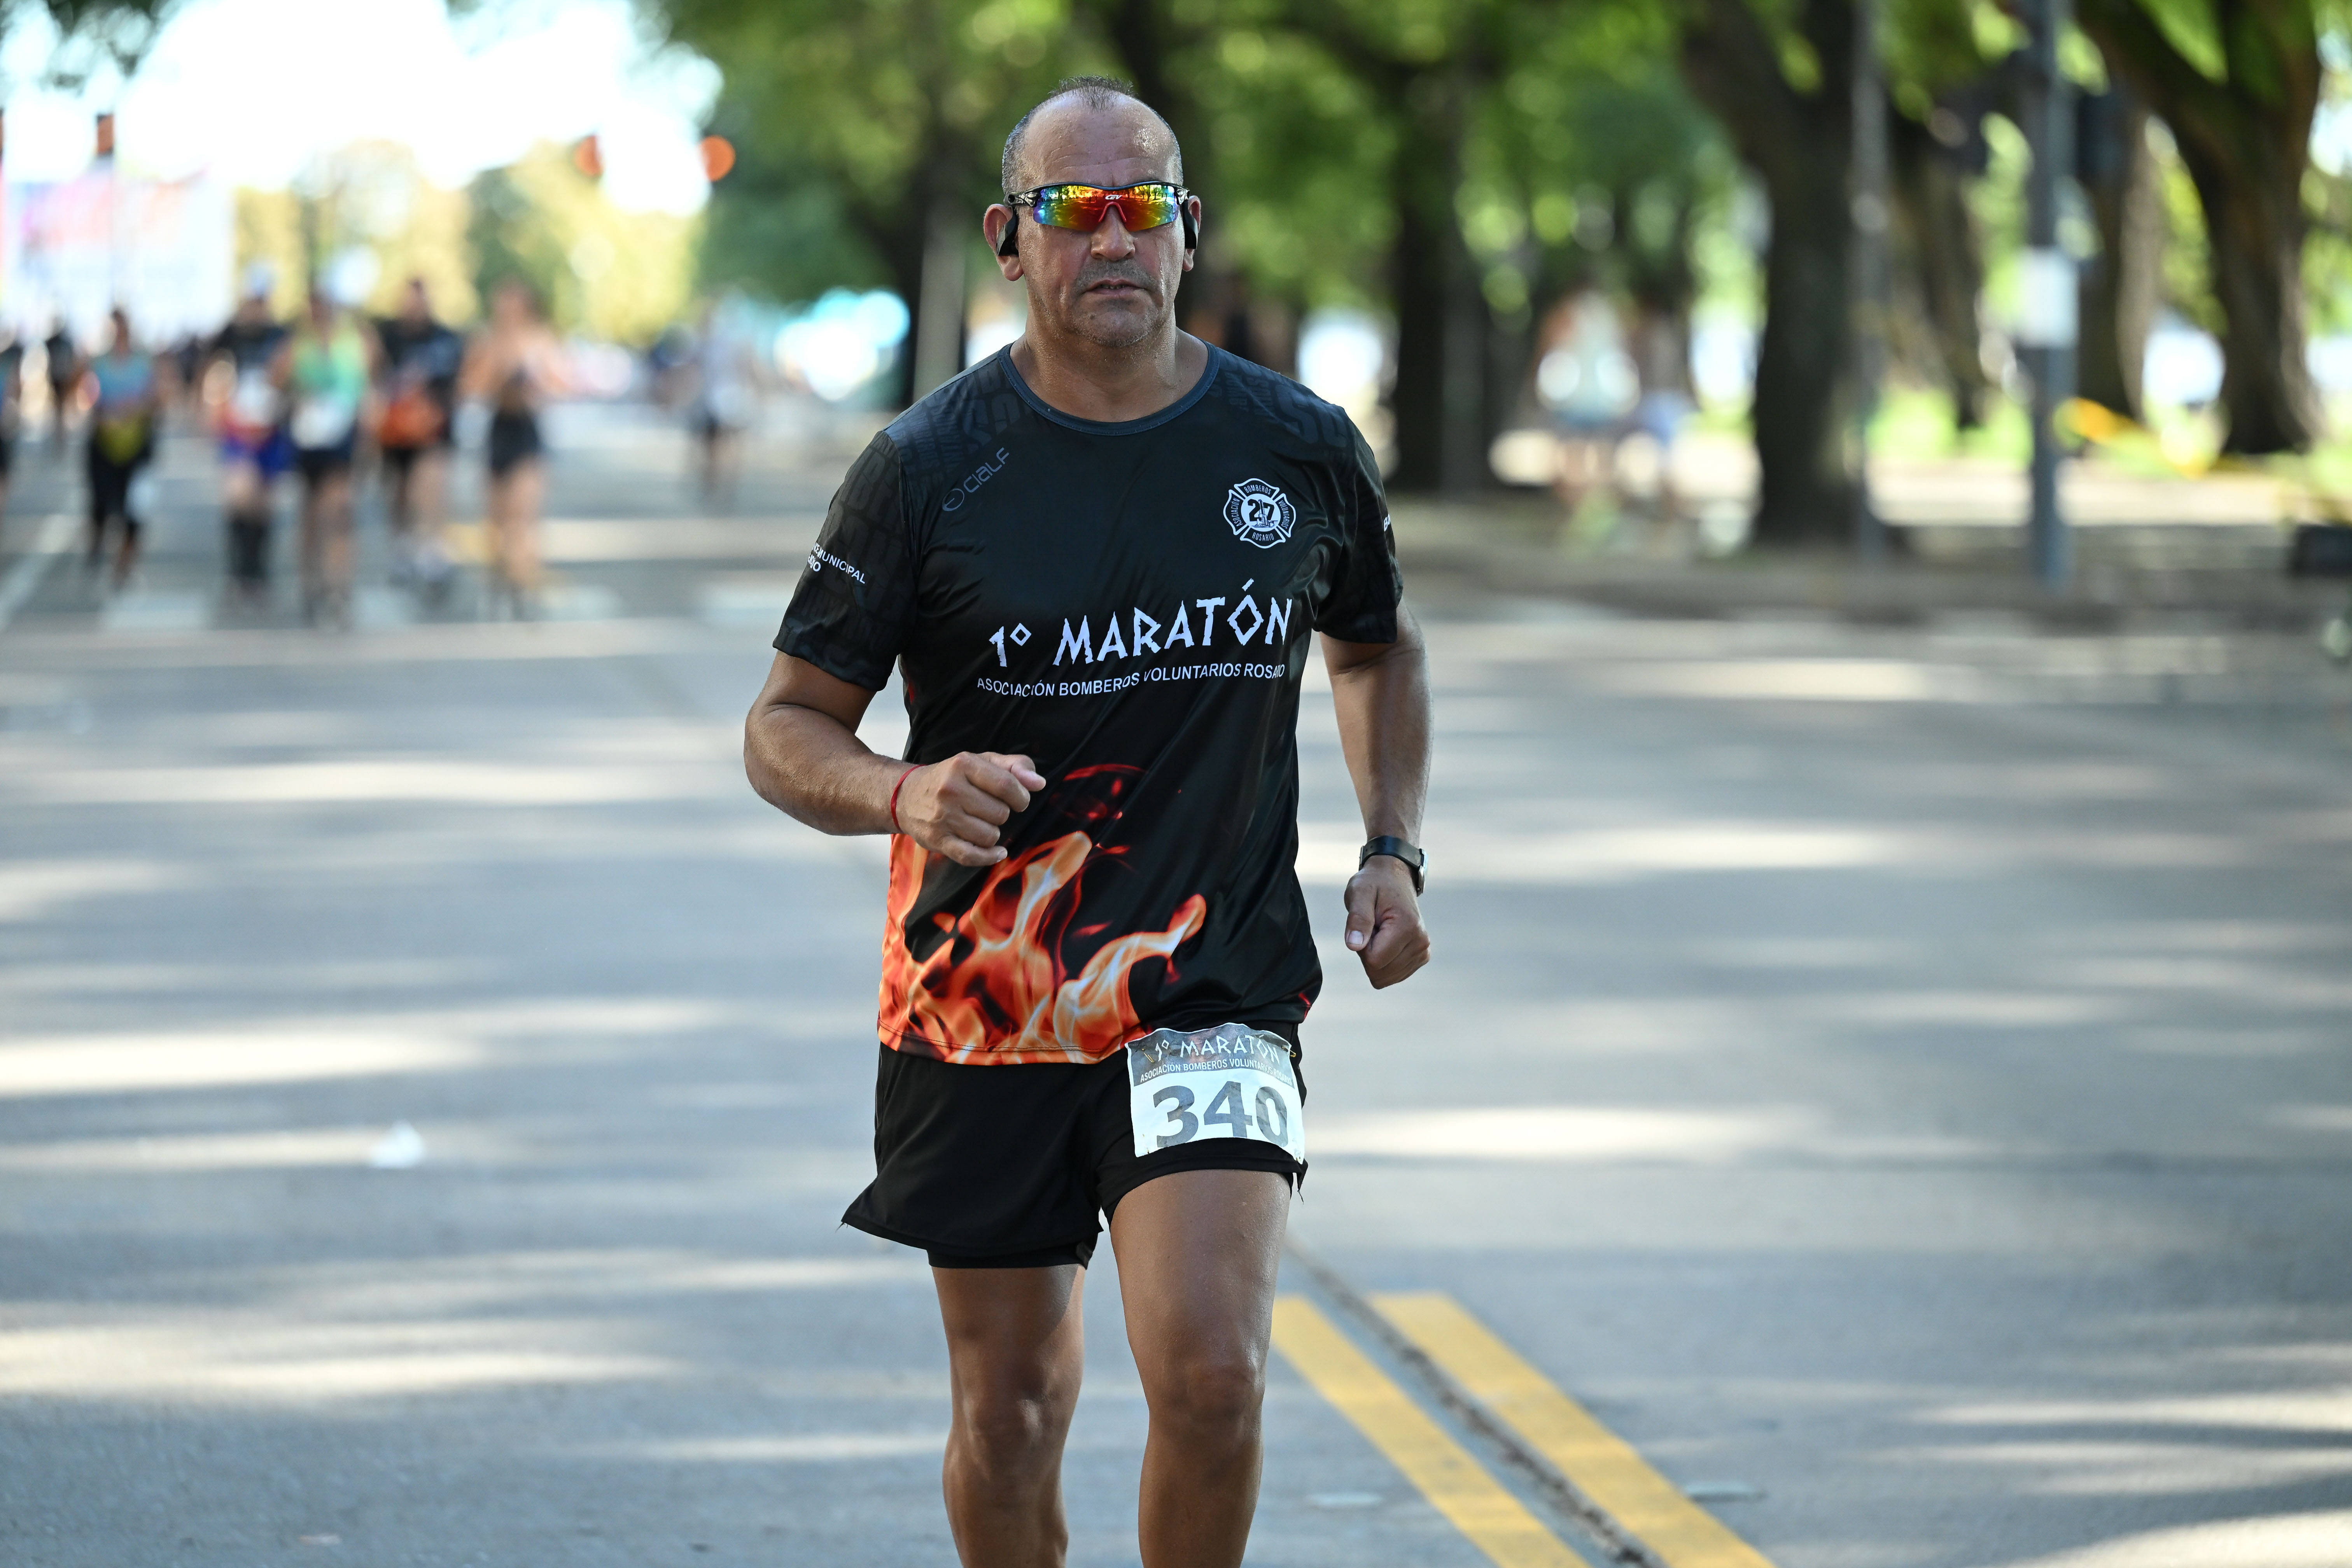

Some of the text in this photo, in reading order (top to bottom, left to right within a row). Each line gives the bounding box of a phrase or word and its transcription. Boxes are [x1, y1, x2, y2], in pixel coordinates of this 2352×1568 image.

[1244, 485, 1271, 495] BOMBEROS
[1247, 499, 1275, 522] 27
[1278, 500, 1290, 529] VOLUNTARIOS
[1251, 532, 1274, 541] ROSARIO
[1052, 578, 1292, 666] MARATÓN
[977, 677, 1055, 697] ASOCIACIÓN
[1059, 672, 1140, 696] BOMBEROS
[1144, 663, 1242, 682] VOLUNTARIOS
[1180, 1034, 1280, 1064] MARATÓN
[1140, 1058, 1292, 1086] ASOCIACIÓN BOMBEROS VOLUNTARIOS ROSARIO
[1153, 1081, 1288, 1148] 340
